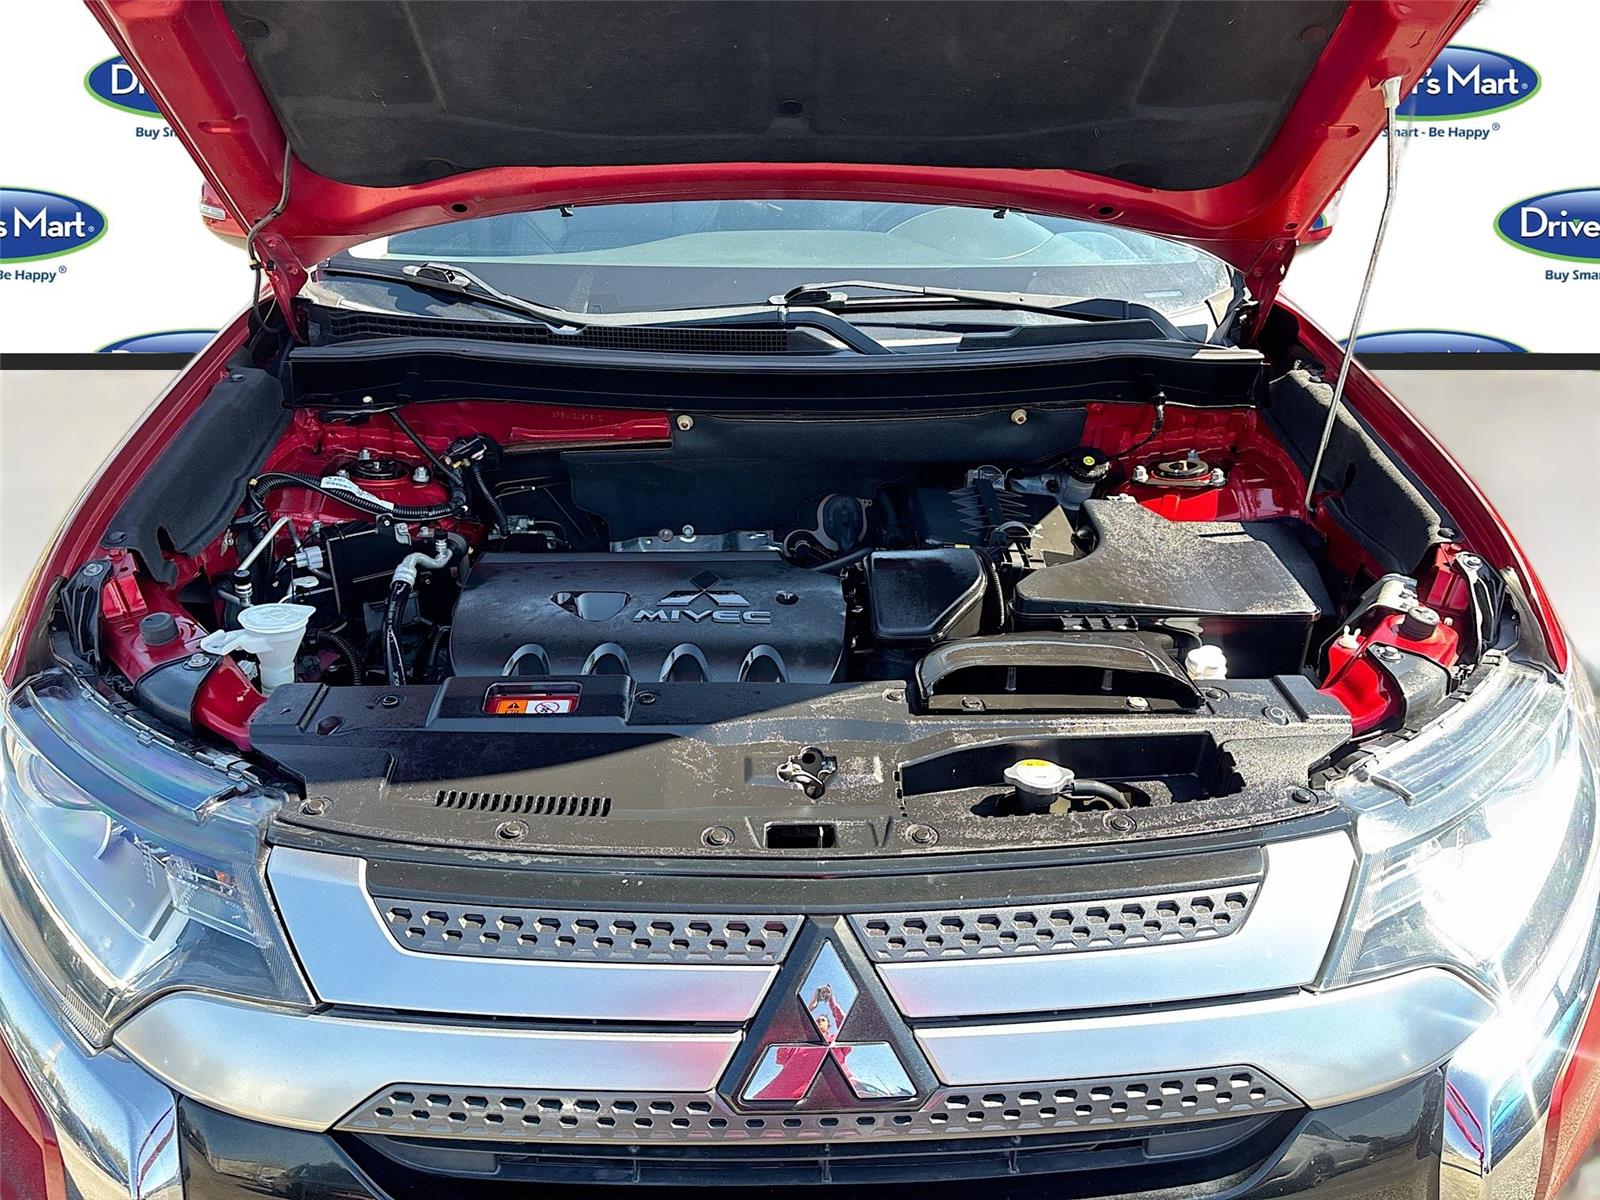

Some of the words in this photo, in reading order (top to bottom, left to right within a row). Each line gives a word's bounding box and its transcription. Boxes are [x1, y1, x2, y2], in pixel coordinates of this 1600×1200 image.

[135, 126, 160, 140] Buy
[1428, 127, 1445, 138] Be
[1545, 269, 1570, 283] Buy
[632, 609, 772, 625] MIVEC
